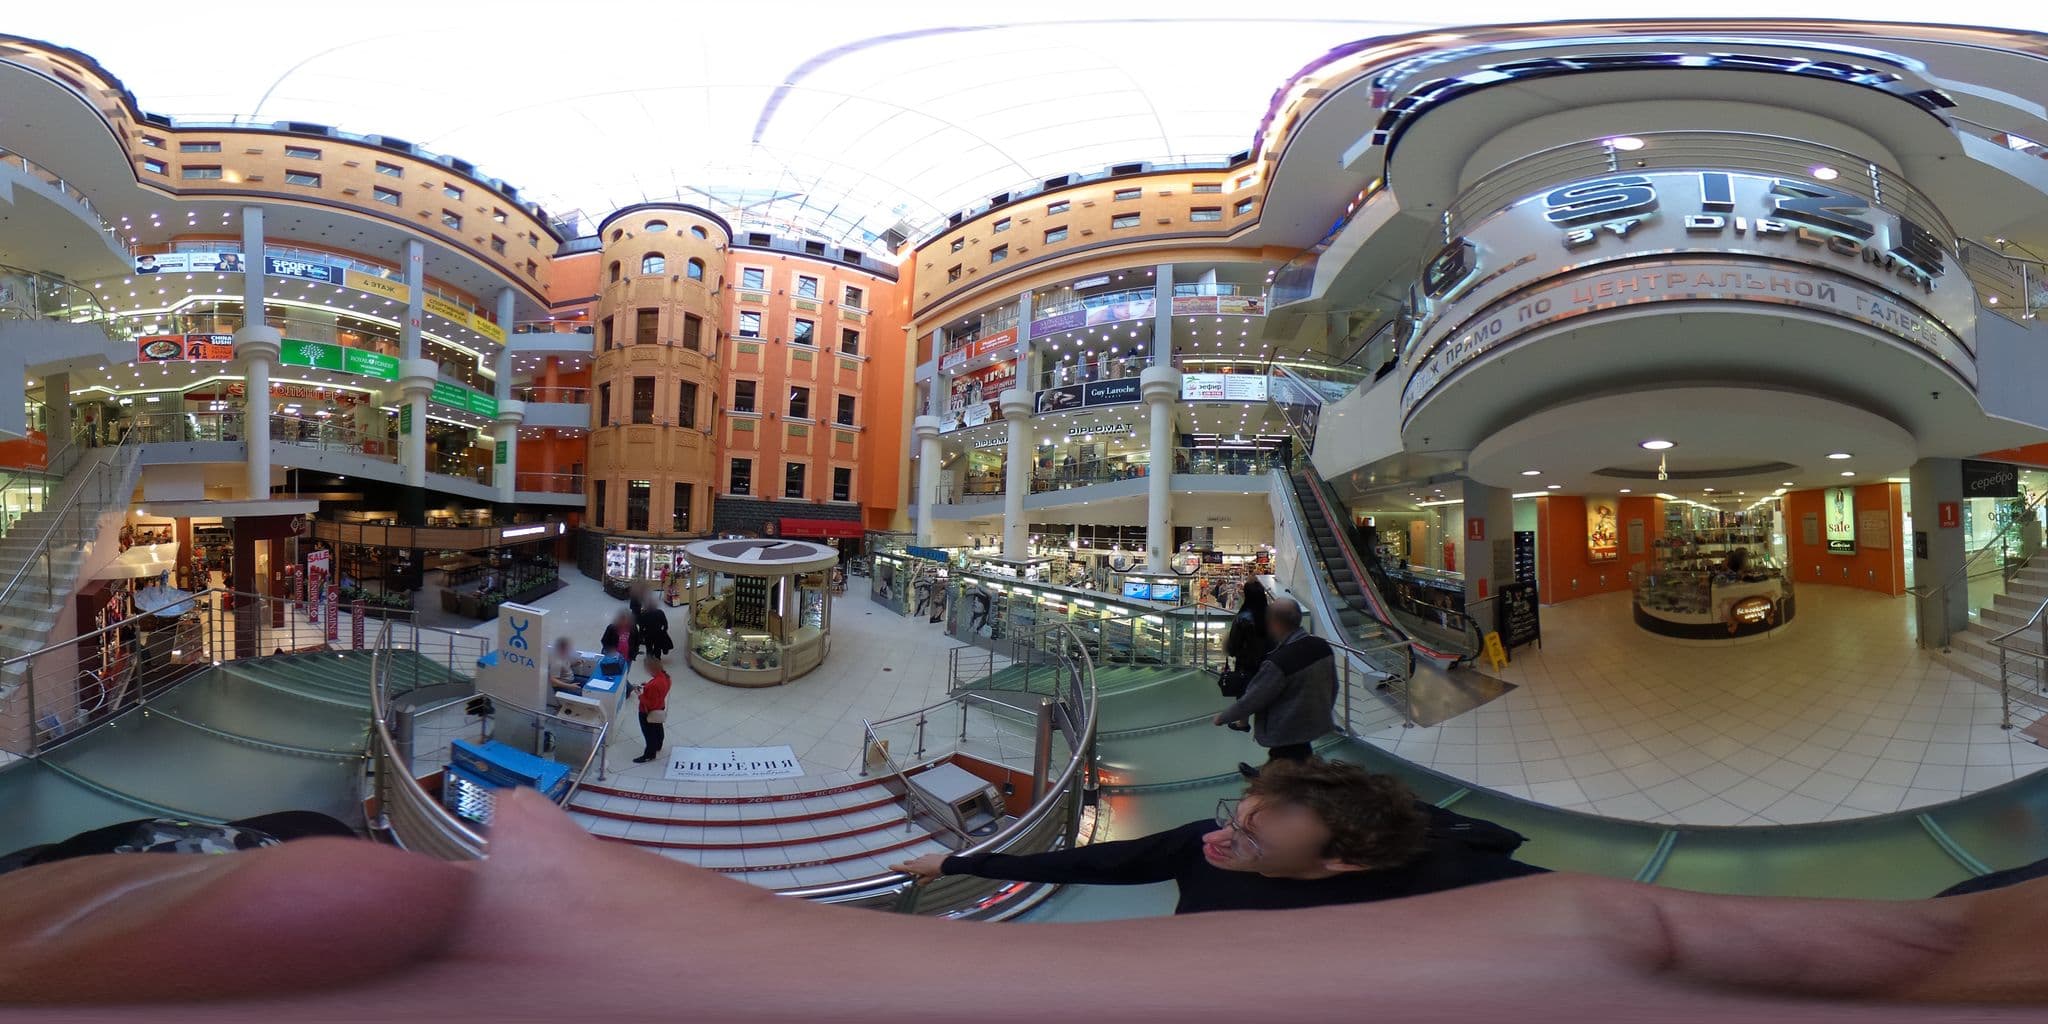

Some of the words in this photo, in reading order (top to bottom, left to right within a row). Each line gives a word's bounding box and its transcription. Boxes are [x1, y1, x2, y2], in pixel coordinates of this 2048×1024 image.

[1543, 172, 1945, 279] SIZE
[1564, 218, 1641, 250] BY
[1684, 214, 1937, 295] DIPLOMAT
[272, 259, 313, 272] SPORT
[275, 265, 303, 276] LIFE
[370, 281, 395, 294] ЭТАЖ
[1445, 318, 1503, 365] ПРЯМО
[1517, 297, 1552, 322] ПО
[1571, 270, 1836, 304] ЦЕНТРАЛЬНОЙ
[1855, 295, 1939, 347] ГАЛЕРЕЕ
[1091, 388, 1105, 398] Guy
[1106, 385, 1135, 395] Laroche
[1068, 423, 1133, 435] DIPLOMAT
[1970, 472, 2014, 493] серебро
[1944, 505, 1952, 521] 1
[1472, 521, 1478, 532] 1
[1828, 521, 1850, 533] sale
[308, 550, 330, 563] SALE
[503, 651, 535, 668] YOTA
[673, 759, 793, 771] БИРРЕРИЯ
[617, 791, 666, 802] СКИДКИ
[815, 786, 853, 797] ВСЕГДА
